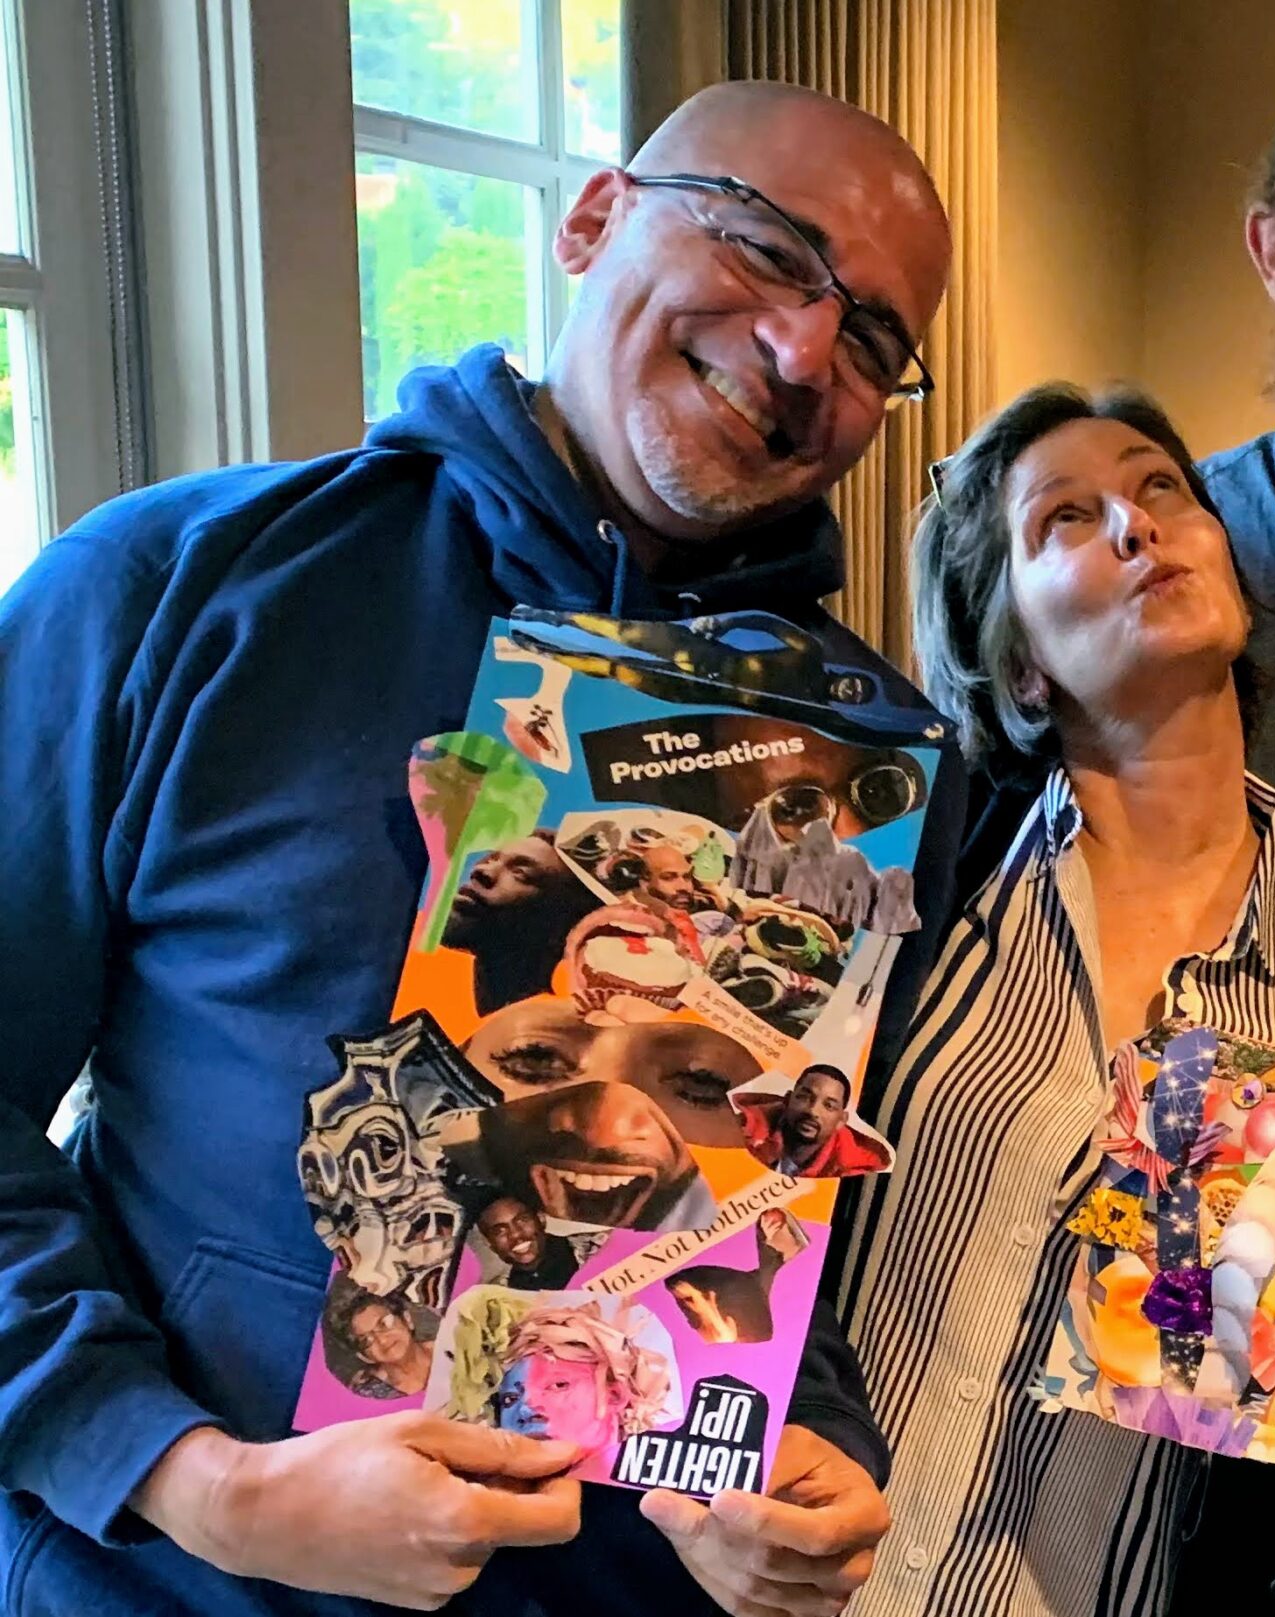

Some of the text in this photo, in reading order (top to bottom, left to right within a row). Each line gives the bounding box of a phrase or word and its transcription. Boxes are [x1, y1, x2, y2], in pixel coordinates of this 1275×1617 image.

[609, 736, 806, 784] Provocations
[642, 731, 700, 755] The
[695, 1000, 711, 1013] for
[711, 1013, 730, 1029] any
[712, 998, 741, 1018] smile
[742, 1015, 772, 1037] that's
[773, 1035, 788, 1048] up
[642, 1235, 692, 1272] Not
[689, 1388, 753, 1443] UP!
[617, 1435, 761, 1494] LIGHTEN
